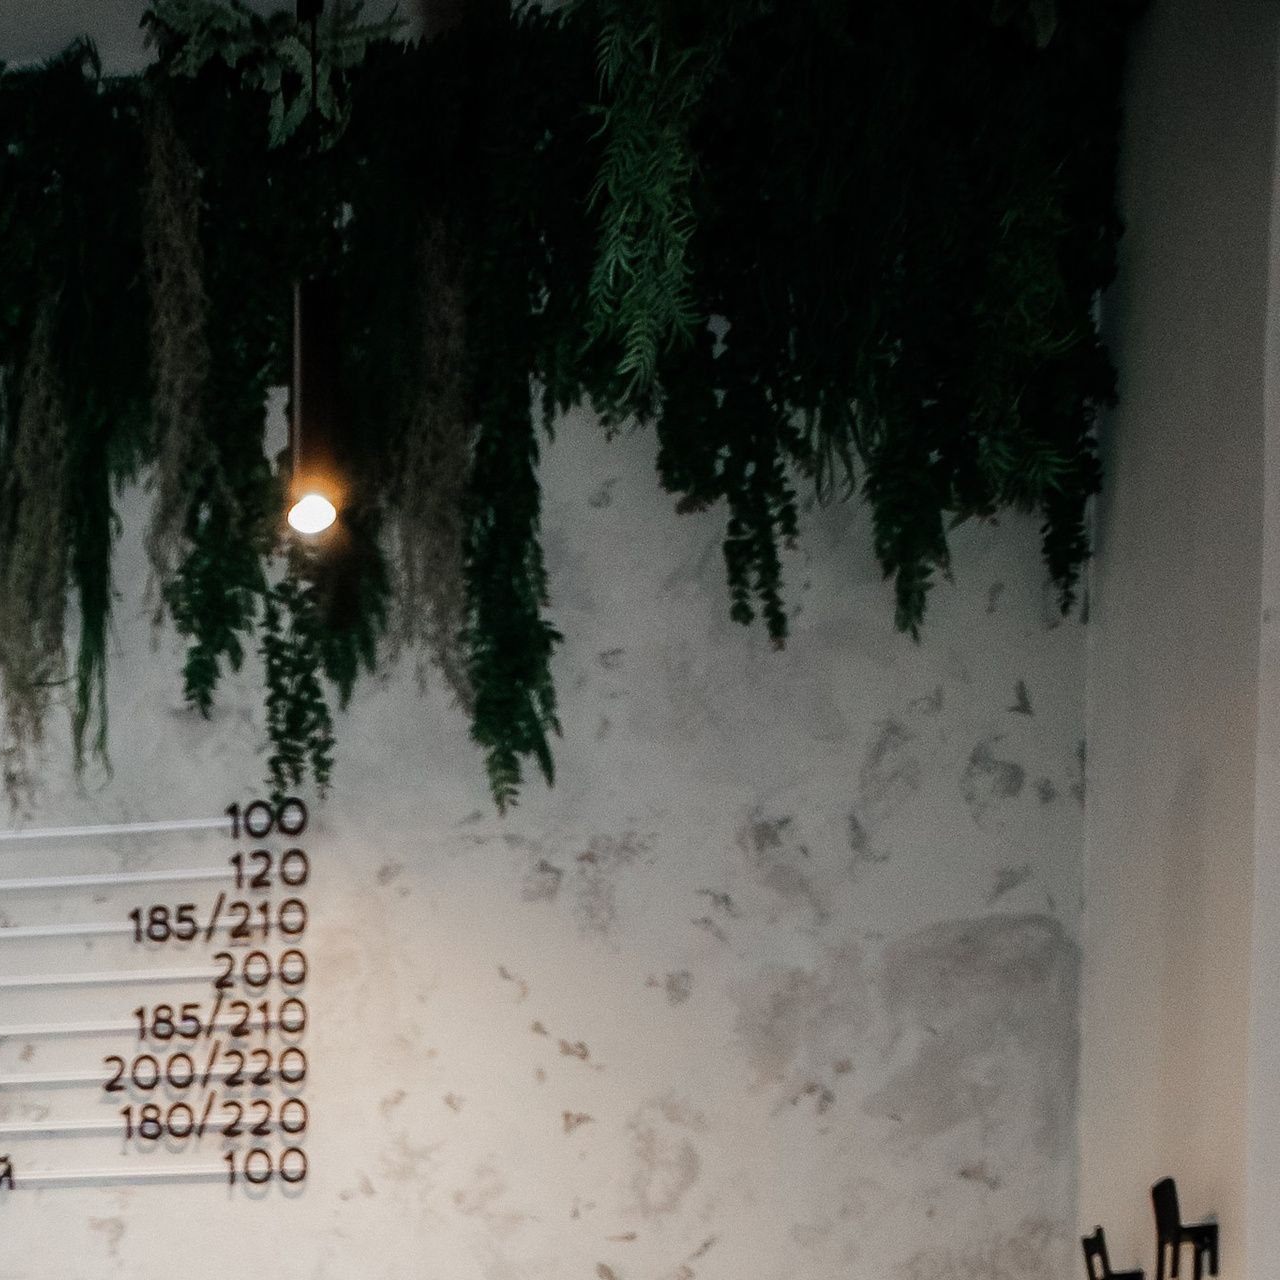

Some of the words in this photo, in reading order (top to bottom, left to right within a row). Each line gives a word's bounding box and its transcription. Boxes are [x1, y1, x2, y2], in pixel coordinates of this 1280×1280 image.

[224, 797, 308, 839] 100
[229, 847, 310, 889] 120
[128, 892, 308, 942] 185/210
[213, 949, 308, 988] 200
[132, 988, 308, 1041] 185/210
[103, 1040, 308, 1092] 200/220
[120, 1091, 309, 1141] 180/220
[223, 1146, 308, 1186] 100
